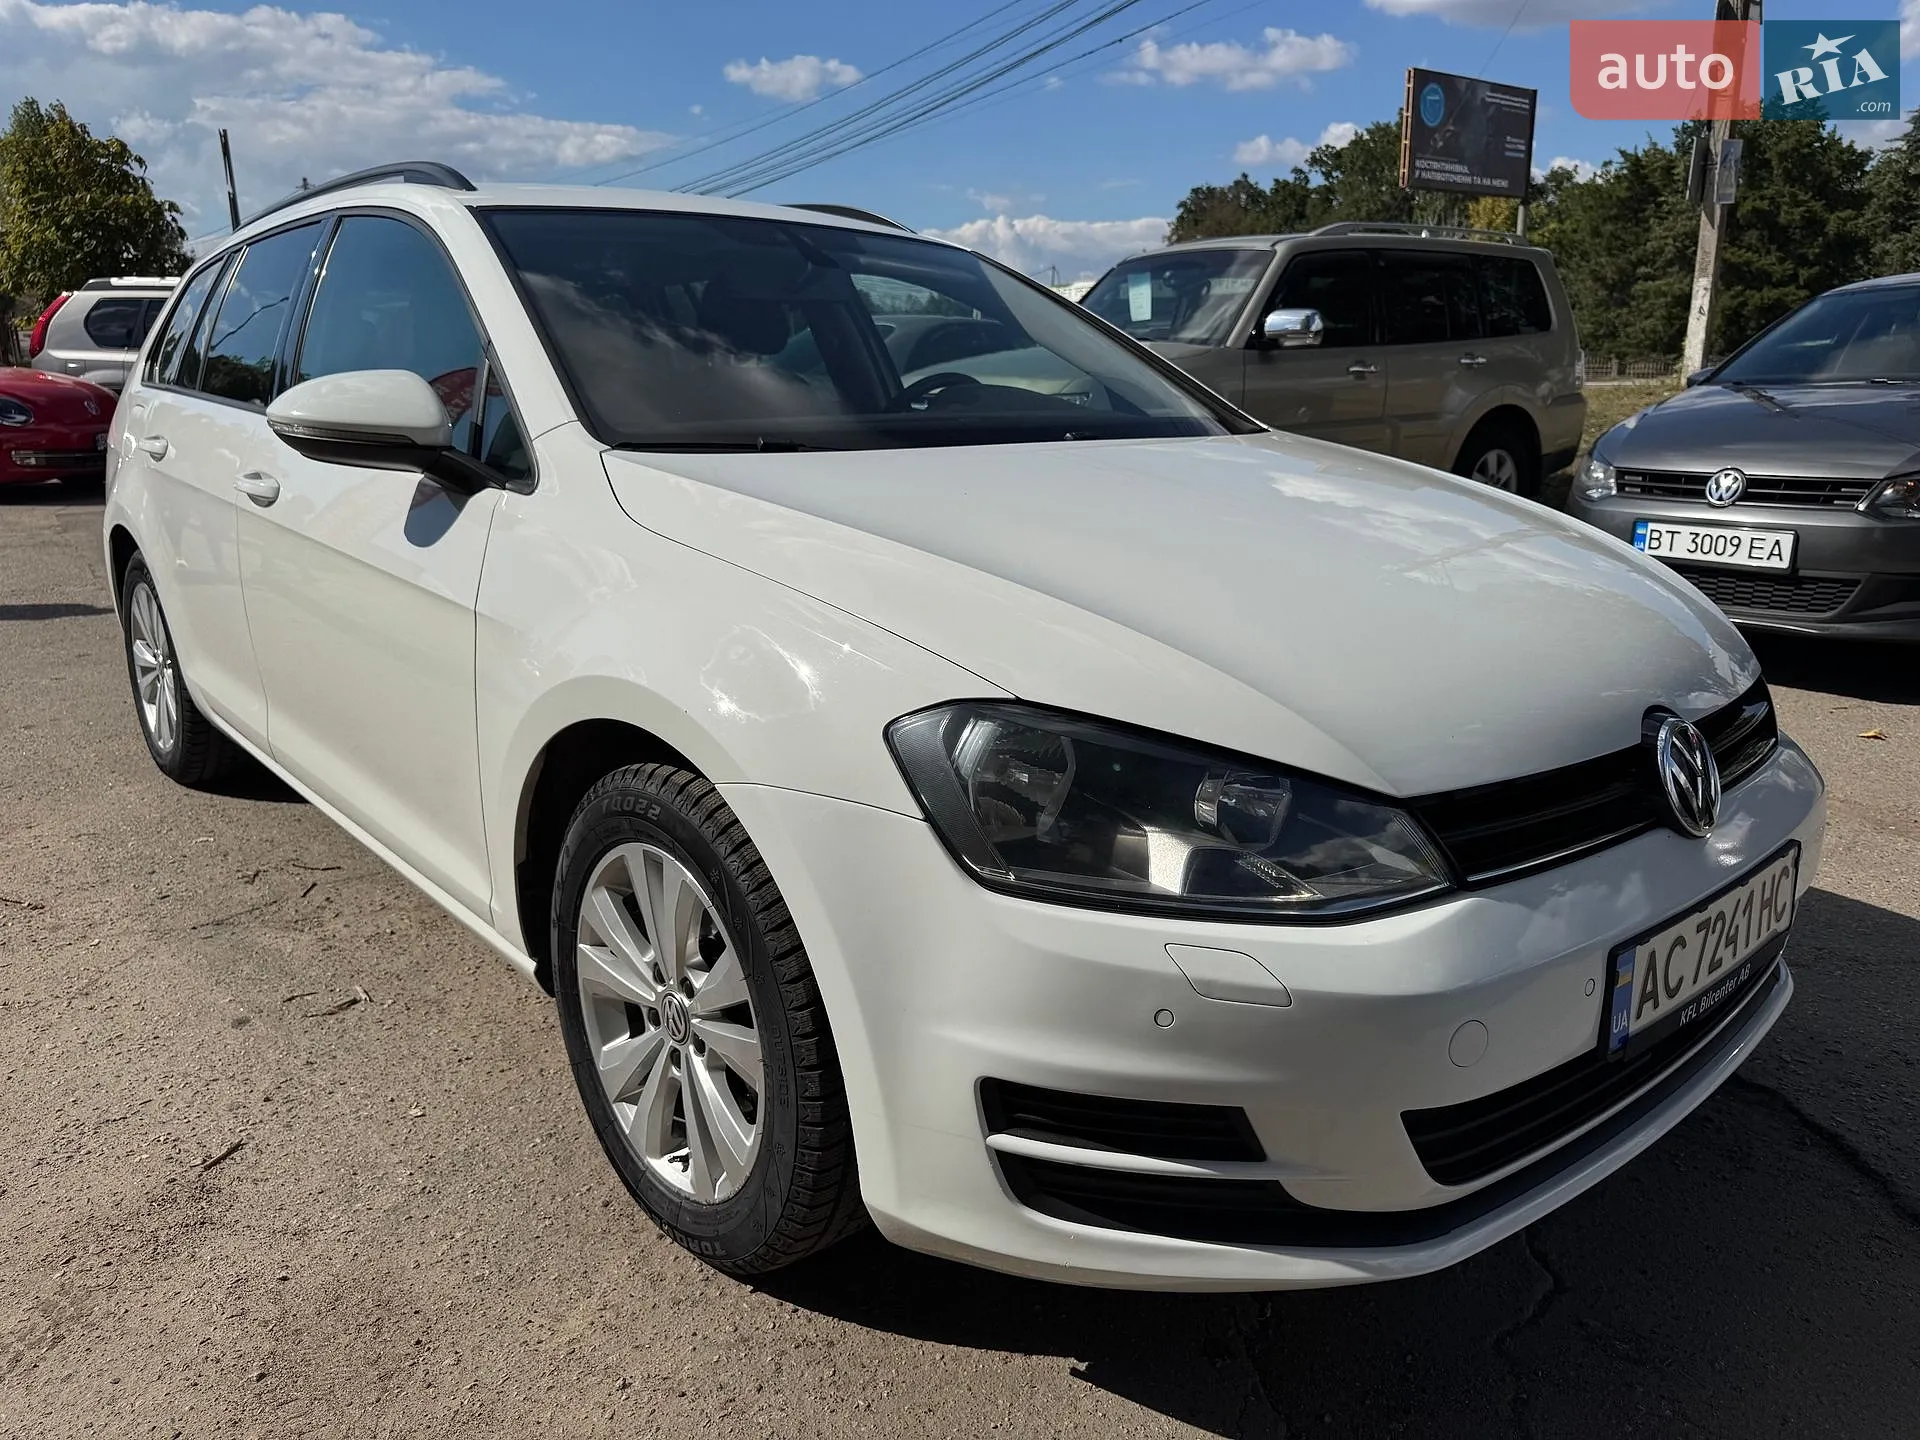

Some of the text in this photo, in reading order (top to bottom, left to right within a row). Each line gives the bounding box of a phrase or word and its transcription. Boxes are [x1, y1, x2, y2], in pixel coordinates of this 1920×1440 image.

[1648, 529, 1784, 562] BT 3009 EA
[1635, 865, 1790, 1020] AC 7241 HC
[1679, 963, 1751, 1027] KFL Bilcenter AB
[1612, 1013, 1628, 1034] UA
